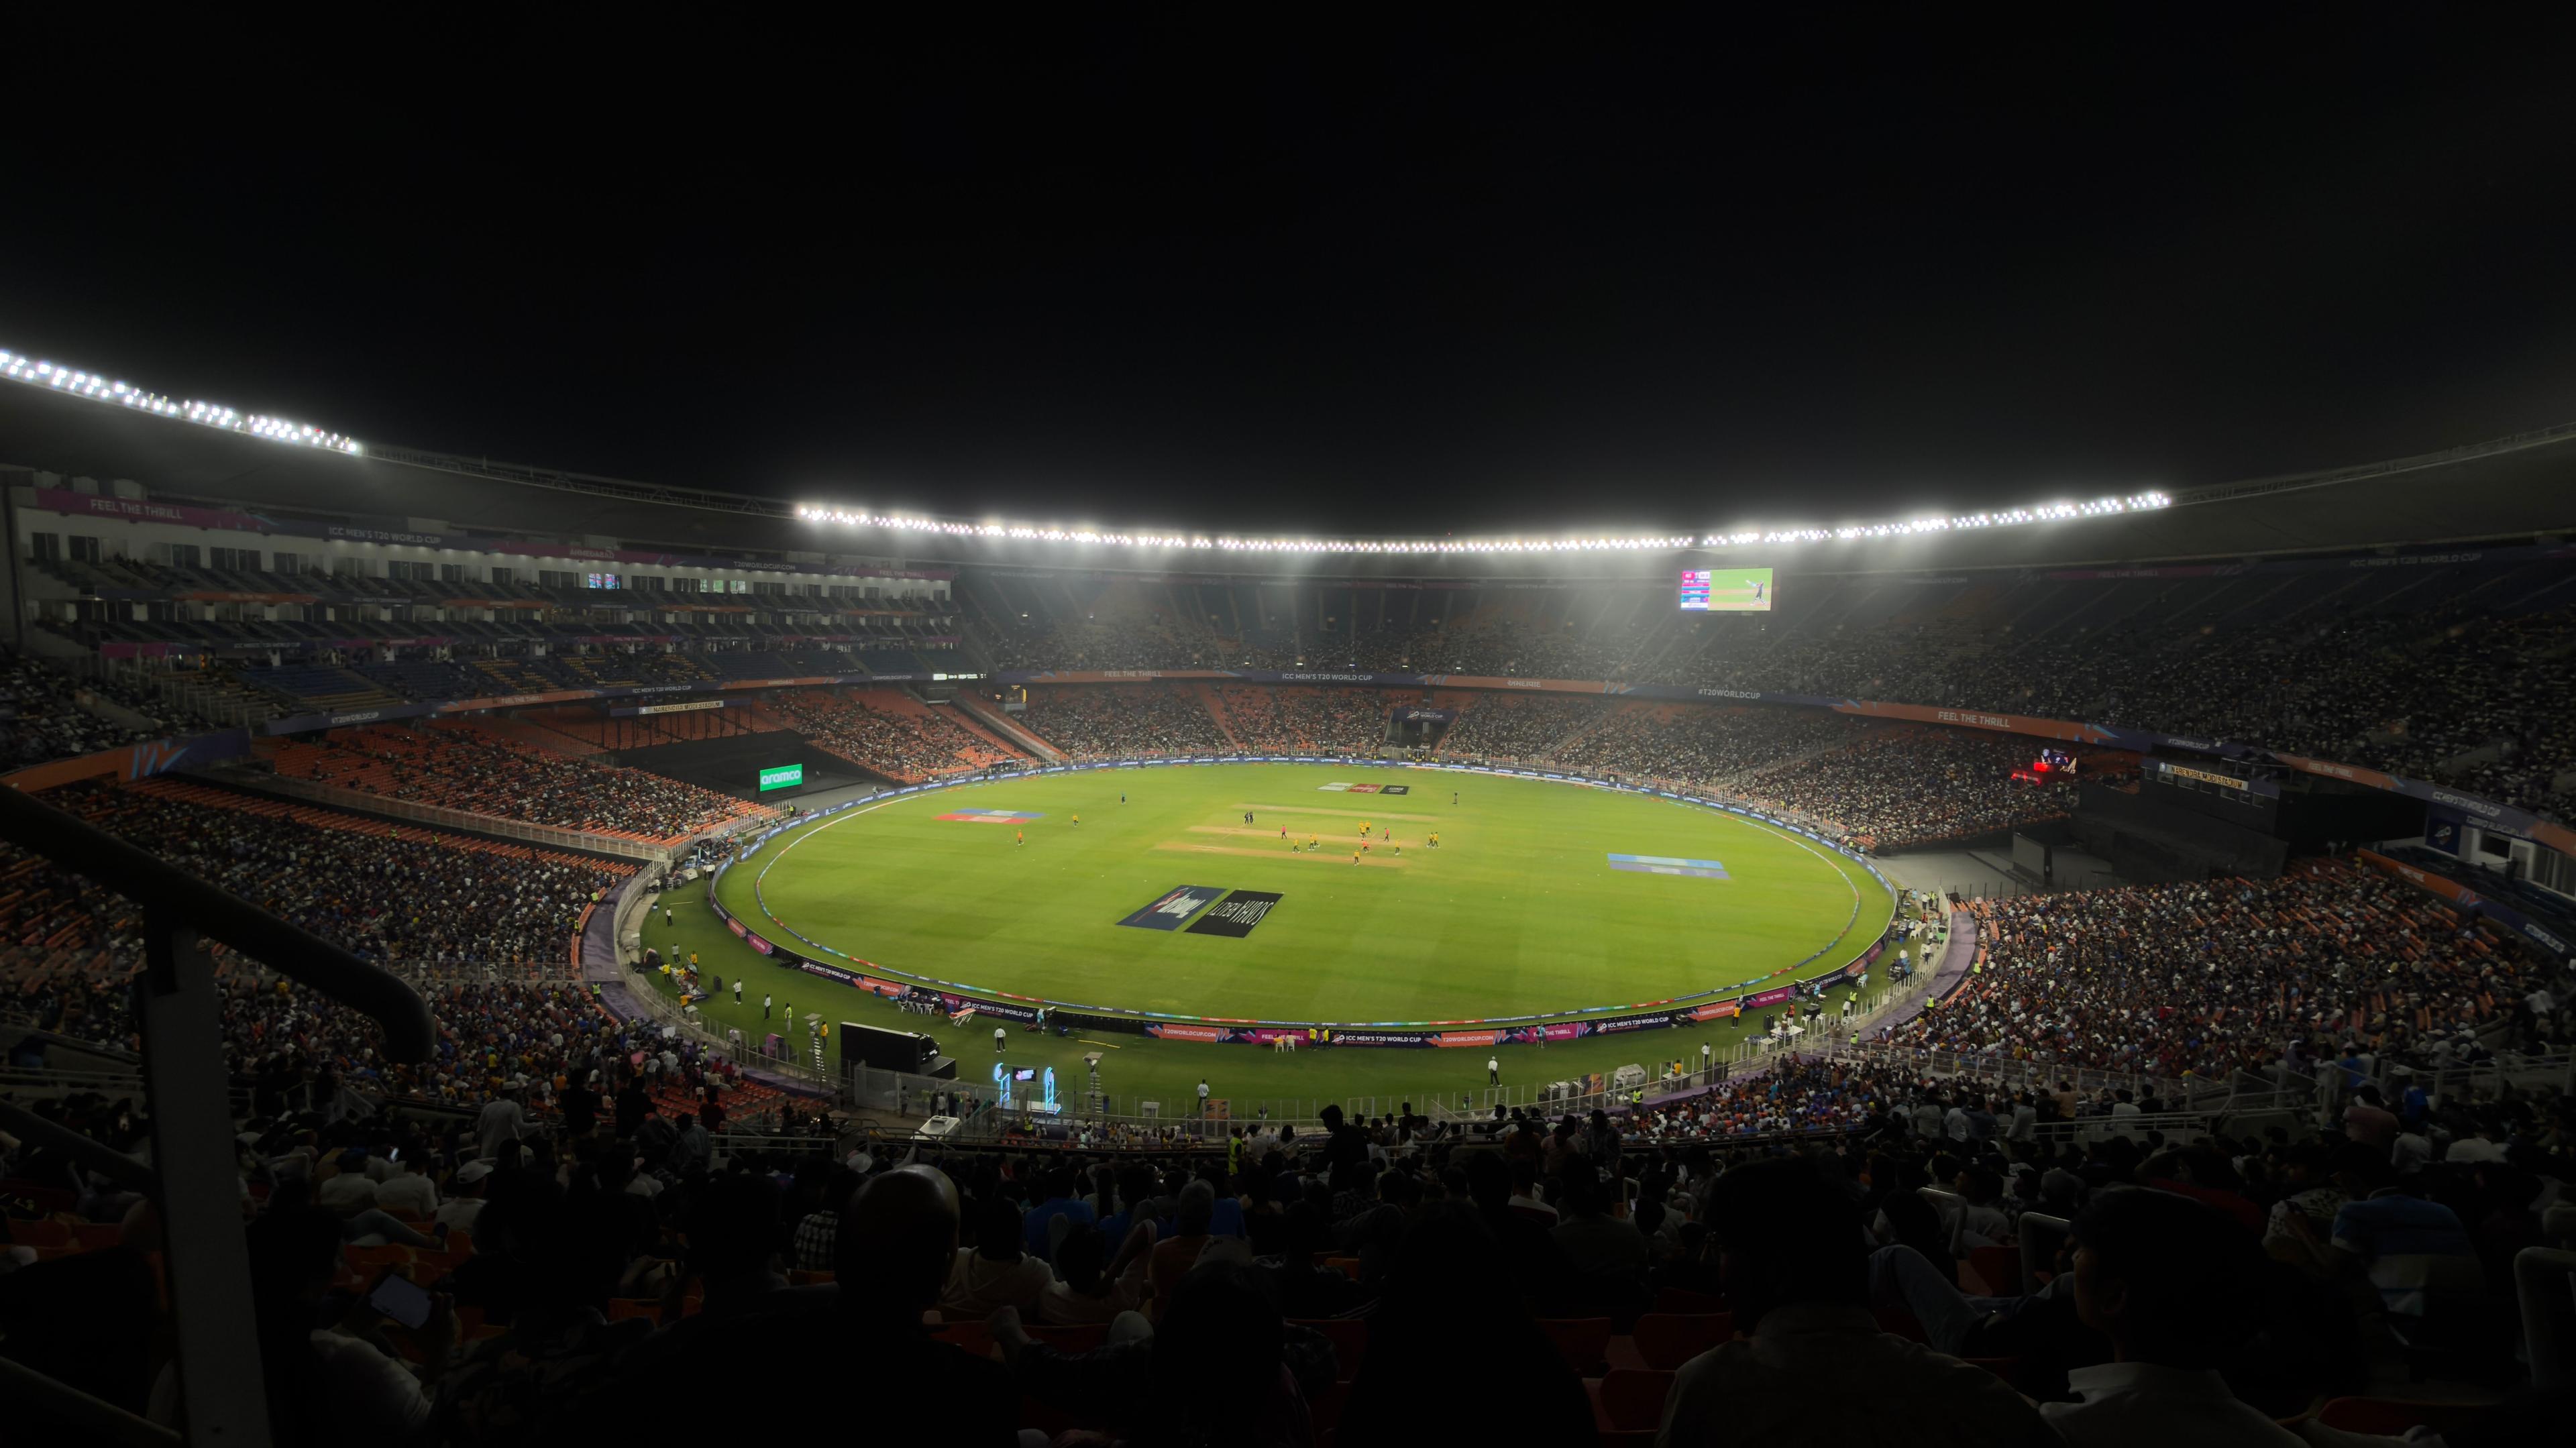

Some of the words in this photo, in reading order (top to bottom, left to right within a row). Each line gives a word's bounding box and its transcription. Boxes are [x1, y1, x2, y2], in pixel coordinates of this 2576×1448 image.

[90, 498, 118, 512] FEEL
[121, 502, 141, 515] THE
[144, 506, 182, 519] THRILL
[329, 526, 344, 536] ICC
[374, 531, 389, 541] T20
[390, 533, 423, 543] WORLD
[425, 536, 441, 544] CUP
[734, 561, 796, 571] T20WORLDCUP.COM
[1698, 688, 1761, 700] #T20WORLDCUP
[1938, 711, 1959, 721] FEEL
[1961, 714, 1978, 724] THE
[1979, 716, 2010, 728] THRILL
[761, 770, 801, 785] aramco
[2171, 766, 2201, 779] NARENDRA
[2218, 776, 2243, 788] STADIUM
[1228, 900, 1274, 926] SOBHA
[831, 970, 843, 978] WORLD
[980, 1004, 996, 1012] MEN'S
[1004, 1008, 1023, 1017] WORLD
[1164, 1028, 1216, 1038] T20WORLDCUP.COM
